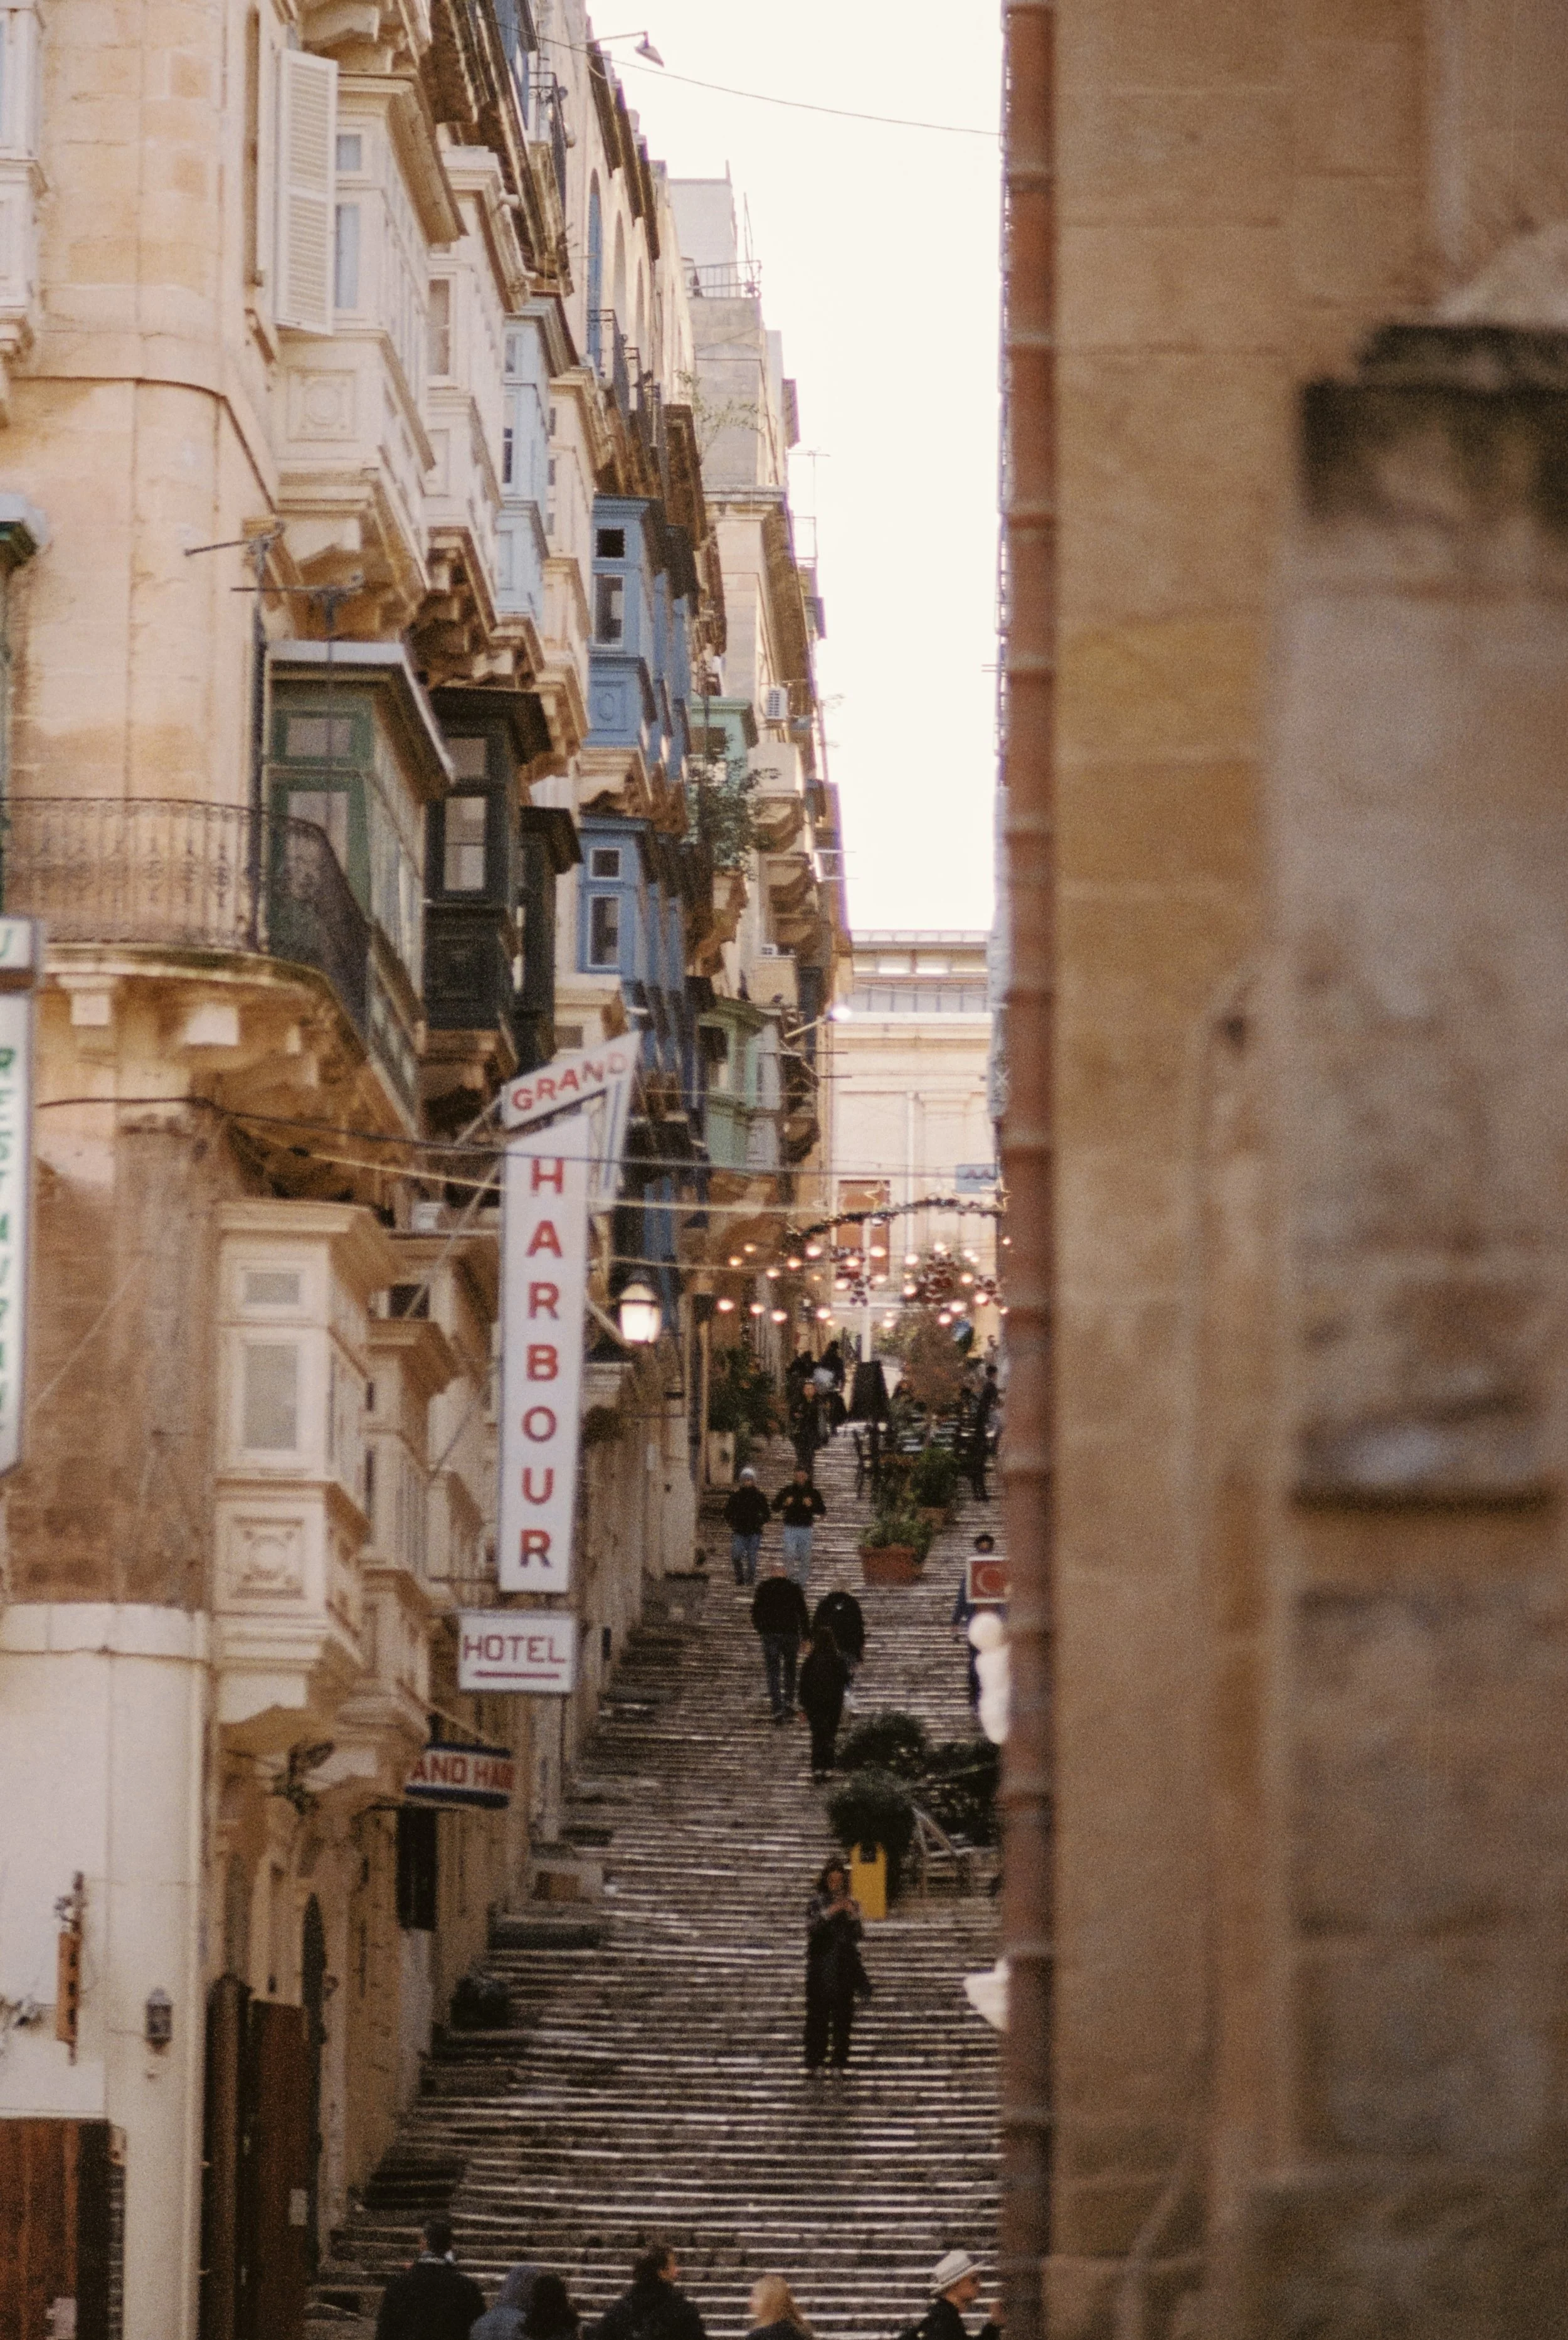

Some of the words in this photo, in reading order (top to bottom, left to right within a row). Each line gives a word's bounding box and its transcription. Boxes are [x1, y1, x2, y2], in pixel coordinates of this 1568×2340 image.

[512, 1052, 628, 1111] GRAND
[519, 1157, 563, 1567] HARBOUR
[464, 1635, 566, 1664] HOTEL
